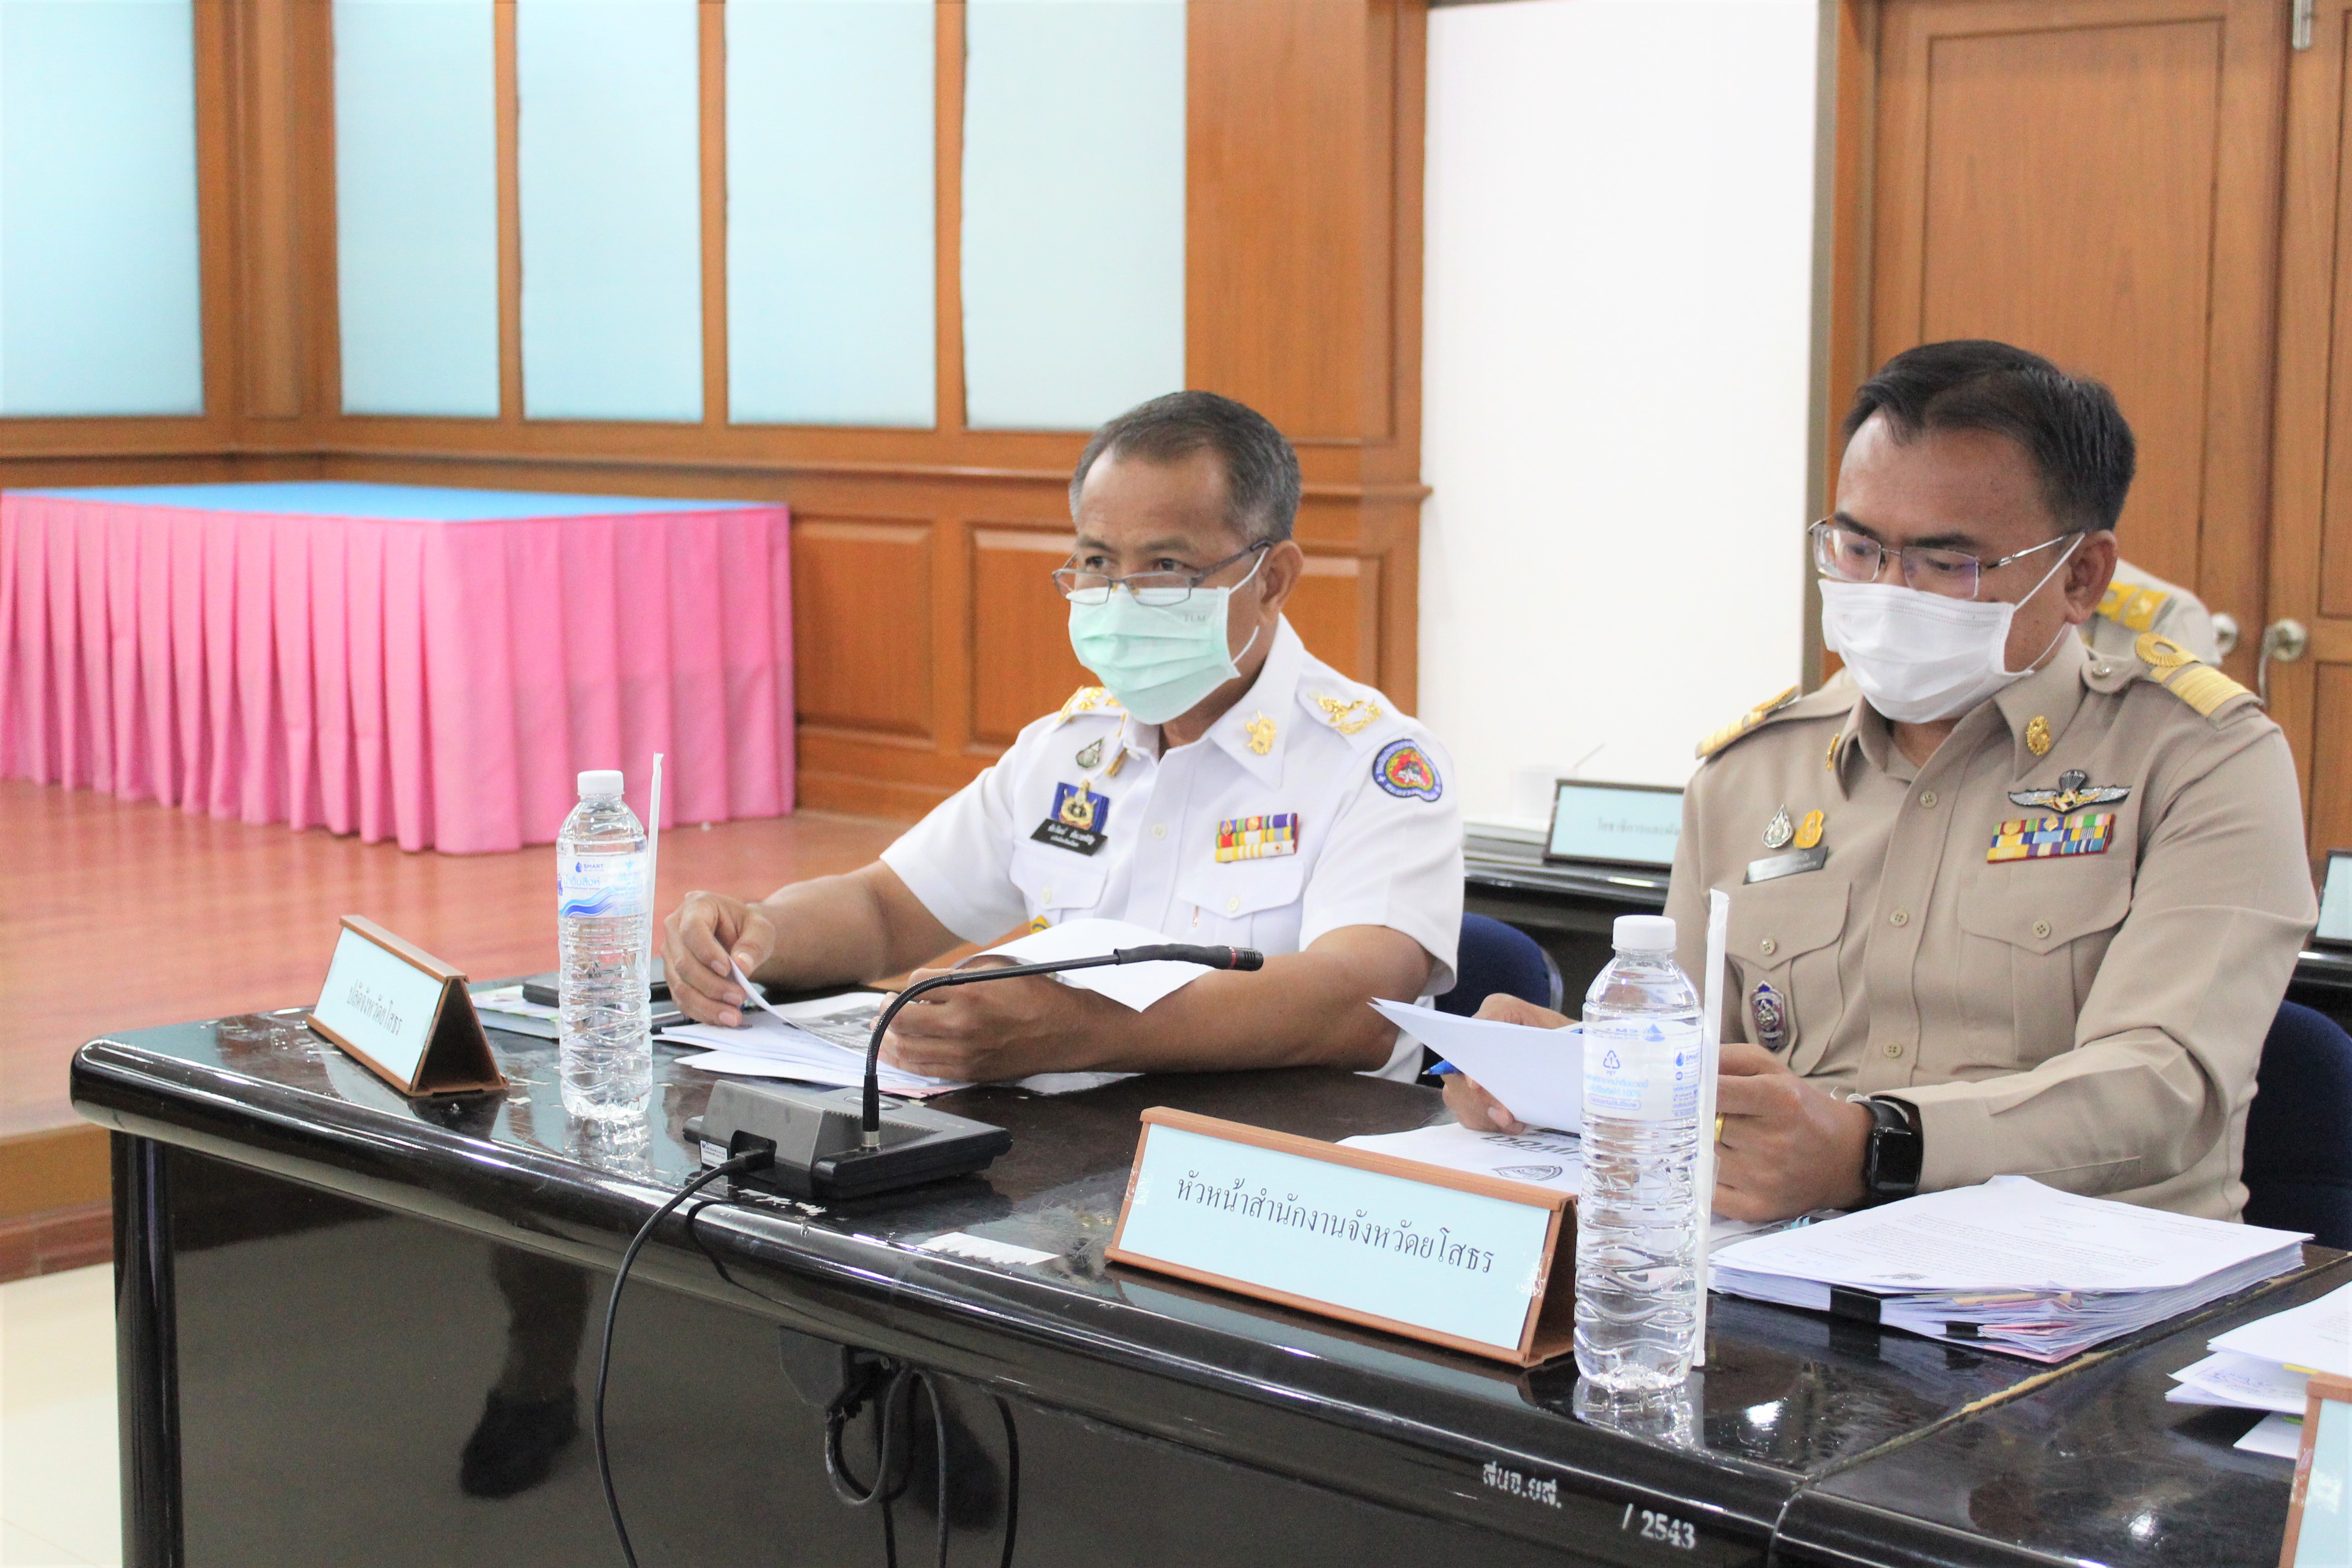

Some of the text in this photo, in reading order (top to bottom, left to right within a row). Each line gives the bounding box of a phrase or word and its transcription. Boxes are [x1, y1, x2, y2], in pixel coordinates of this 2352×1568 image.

[1178, 1170, 1495, 1273] หัวหน้าสำนักงานจังหวัดยโสธร
[1641, 1509, 1695, 1549] 2543
